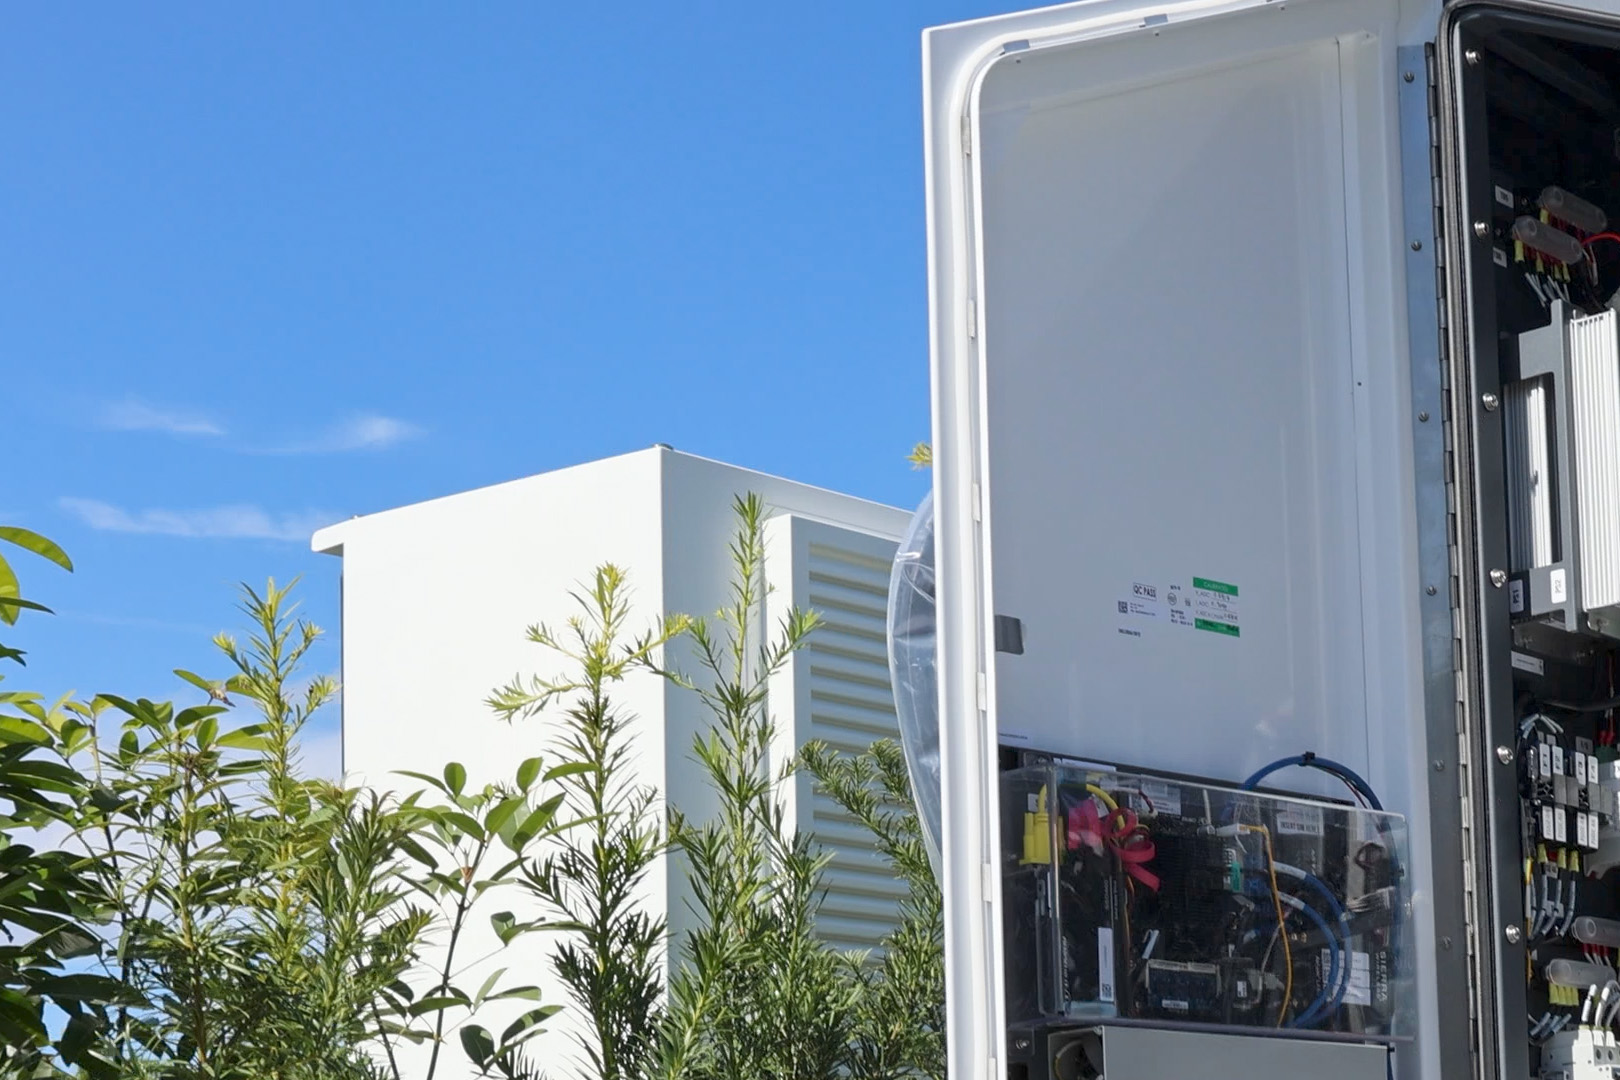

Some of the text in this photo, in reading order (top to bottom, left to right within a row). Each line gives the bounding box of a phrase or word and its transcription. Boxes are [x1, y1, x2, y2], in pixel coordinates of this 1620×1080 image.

[1133, 584, 1156, 598] QC PASS
[1379, 951, 1388, 1002] SIERRA
